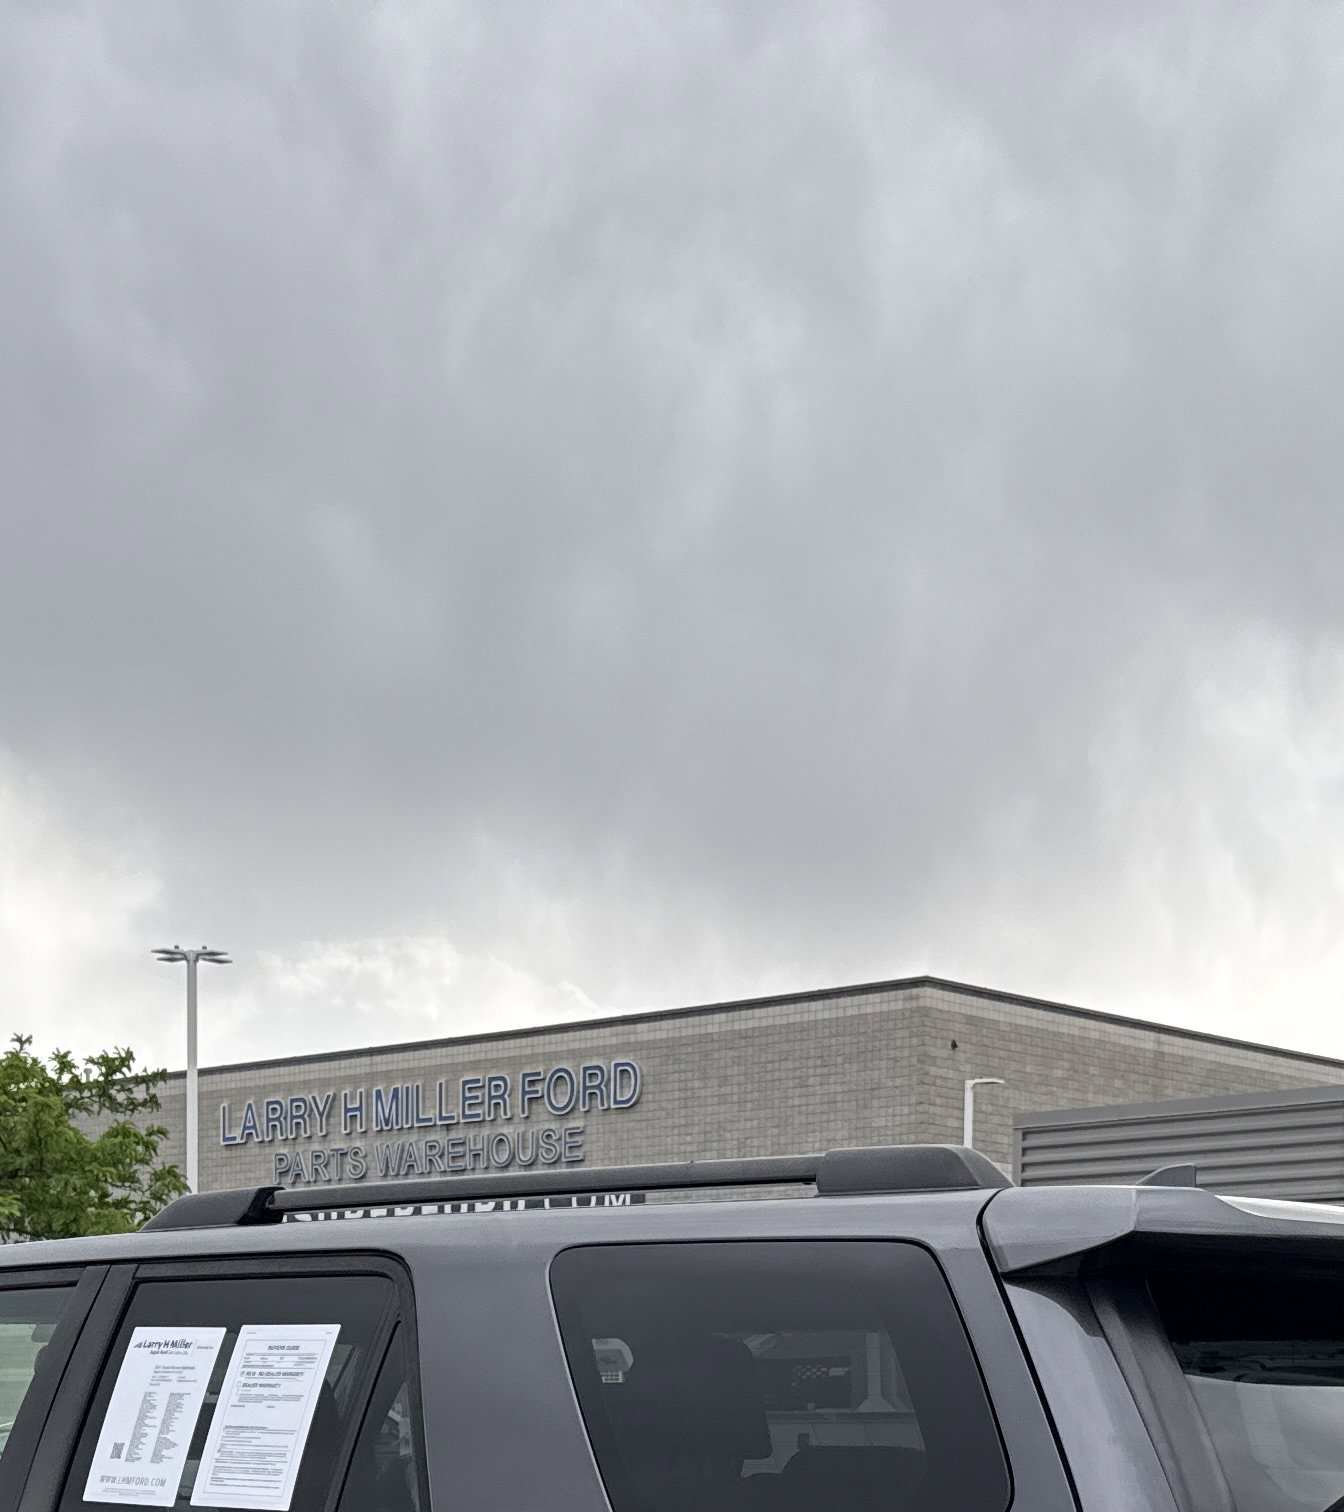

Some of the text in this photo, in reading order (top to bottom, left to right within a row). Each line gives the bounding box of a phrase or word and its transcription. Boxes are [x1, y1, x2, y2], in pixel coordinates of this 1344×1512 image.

[219, 1060, 641, 1145] LARRY H MILLER FORD
[273, 1126, 585, 1184] PARTS WAREHOUSE
